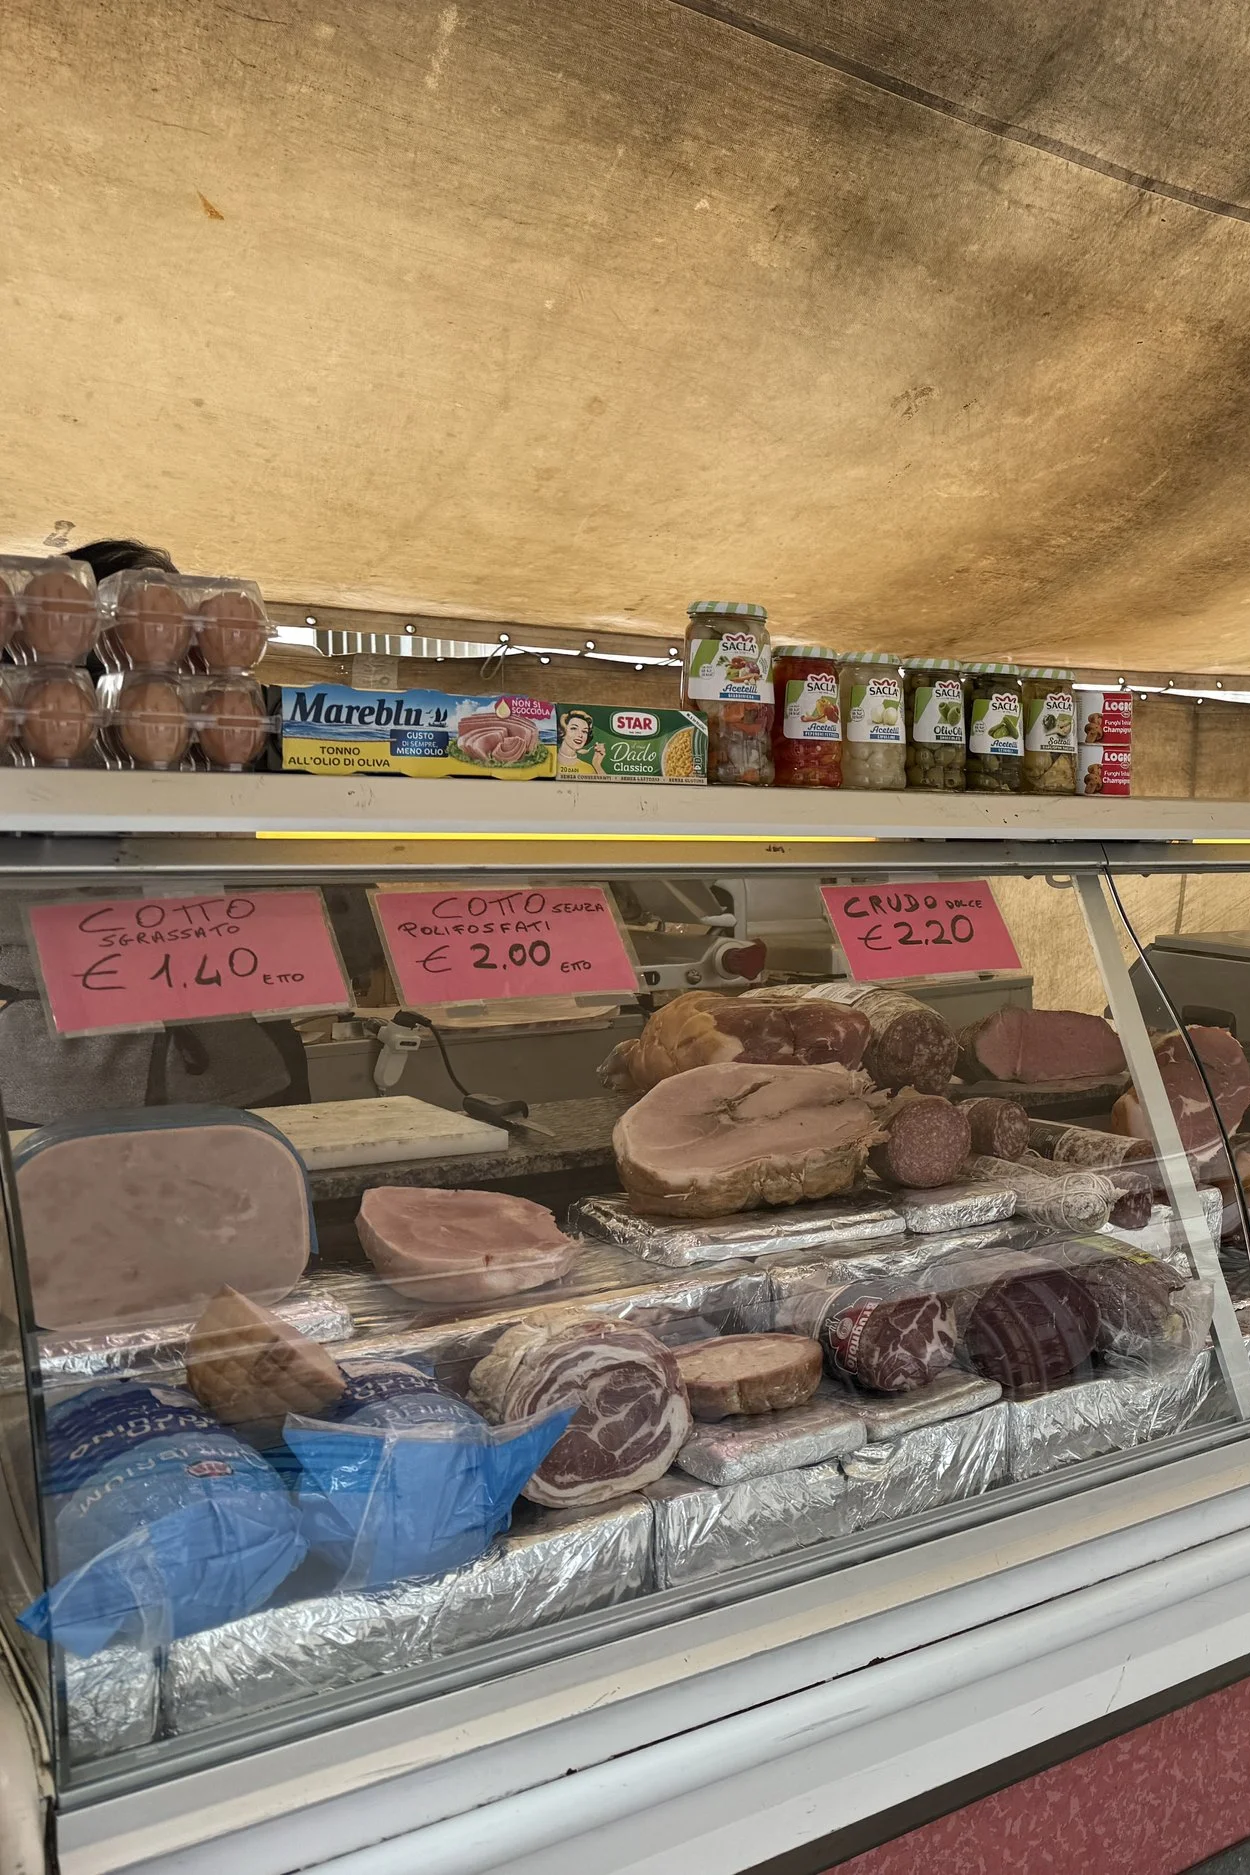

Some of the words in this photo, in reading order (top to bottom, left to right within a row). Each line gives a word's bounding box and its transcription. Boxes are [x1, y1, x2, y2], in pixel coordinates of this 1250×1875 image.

[723, 684, 757, 694] Acetelli
[290, 692, 424, 726] Mareblu
[512, 706, 551, 716] SGOCCIOLA
[617, 716, 652, 730] STAR
[807, 722, 836, 732] Acetelli
[406, 732, 434, 740] GUSTO
[320, 746, 360, 756] TONNO
[396, 748, 423, 756] MENO
[424, 748, 444, 756] OLIO
[610, 742, 657, 762] Dado
[288, 756, 340, 766] ALL'OLIO
[344, 758, 354, 766] DI
[358, 758, 390, 768] OLIVA
[614, 762, 654, 773] Classico
[432, 892, 546, 919] COTTO
[552, 902, 604, 914] SENZA
[844, 893, 938, 918] CRUDO
[945, 899, 982, 910] DOLCE
[78, 898, 255, 933] COTTO
[98, 922, 240, 948] SGRASSATO
[398, 920, 551, 938] POLIFOSFATI
[857, 924, 892, 951] €
[894, 914, 974, 946] 2.20
[416, 944, 452, 973] €
[470, 940, 550, 970] 2.00
[72, 954, 127, 990] €
[150, 948, 258, 988] 1.40
